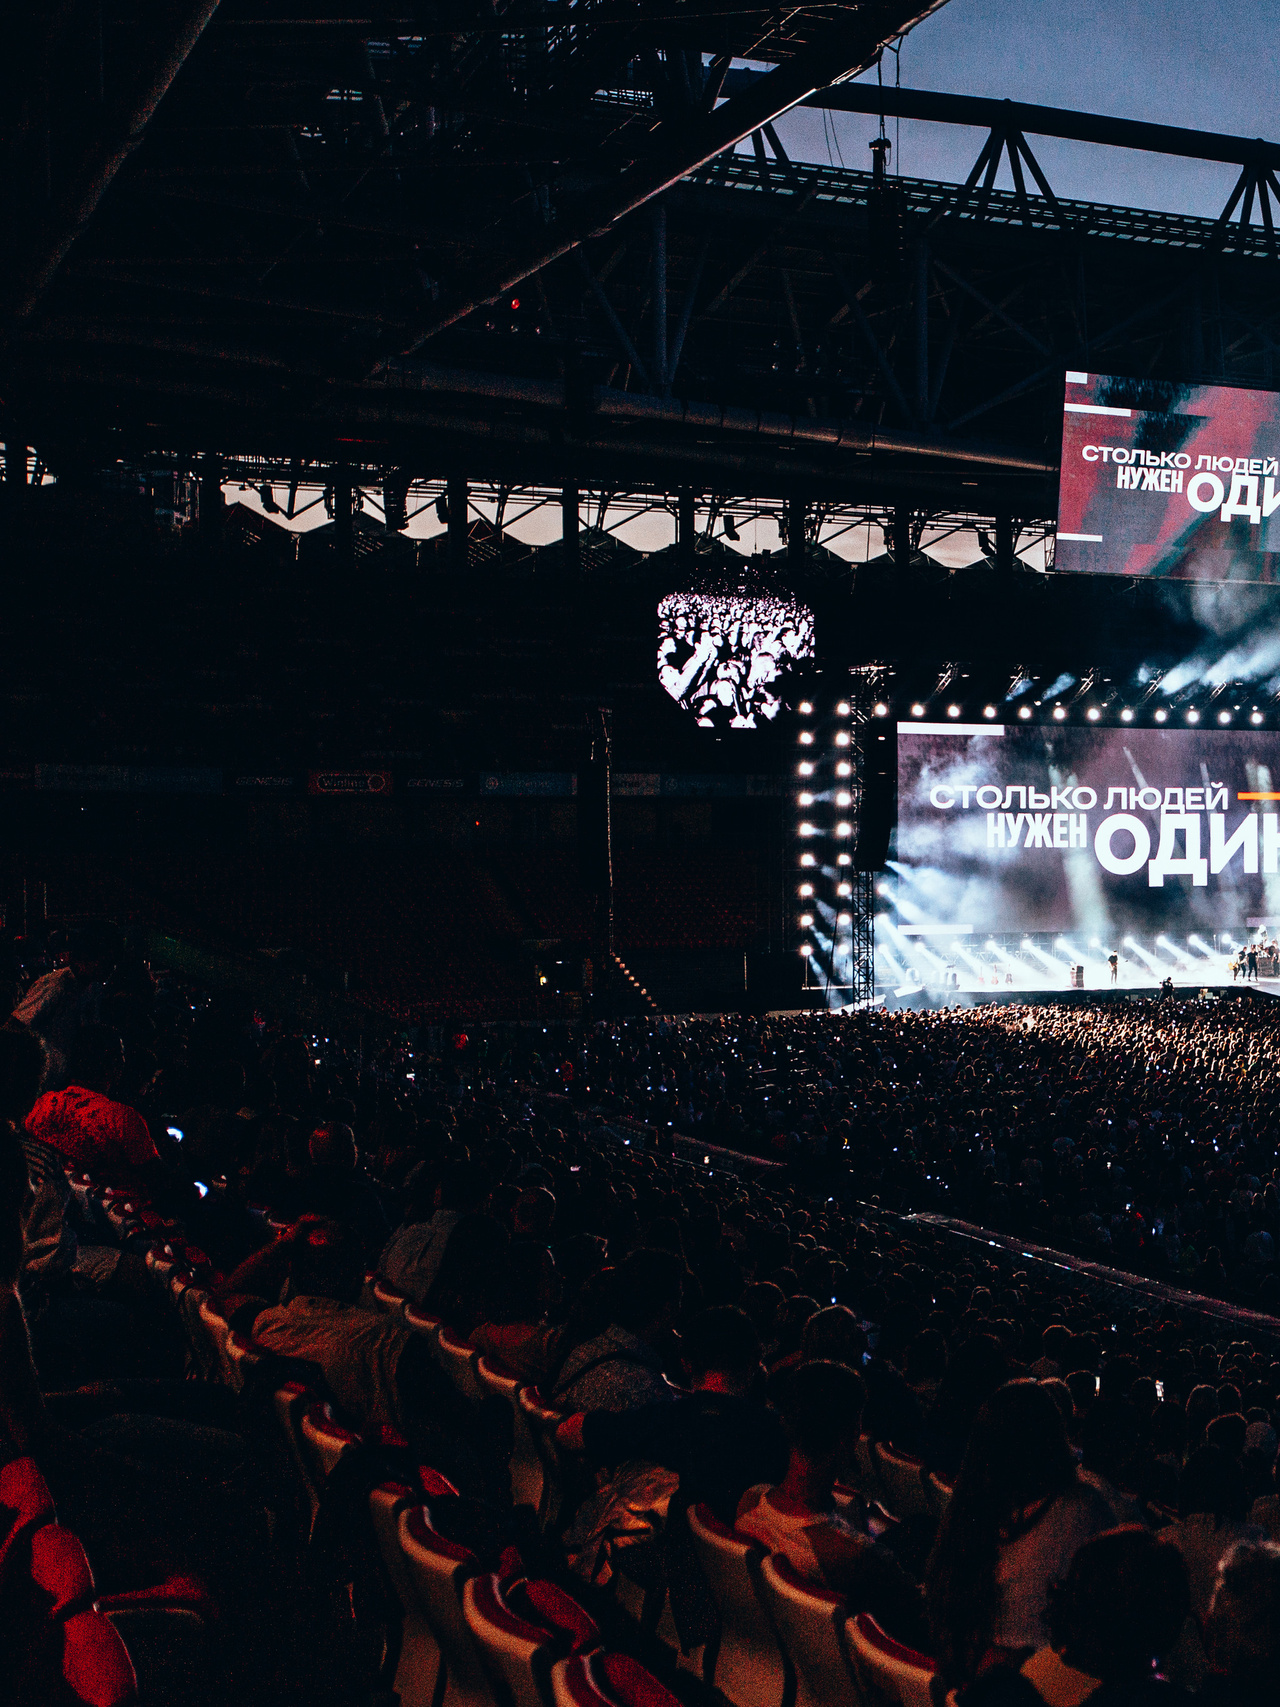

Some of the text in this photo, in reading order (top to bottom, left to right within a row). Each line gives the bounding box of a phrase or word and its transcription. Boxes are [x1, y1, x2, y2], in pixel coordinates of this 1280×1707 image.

[1081, 445, 1279, 476] СТОЛЬКО ЛЮДЕЙ
[1116, 465, 1184, 493] НУЖЕН
[407, 778, 464, 789] GENESIS
[928, 782, 1229, 814] СТОЛЬКО ЛЮДЕЙ
[986, 812, 1088, 848] НУЖЕН
